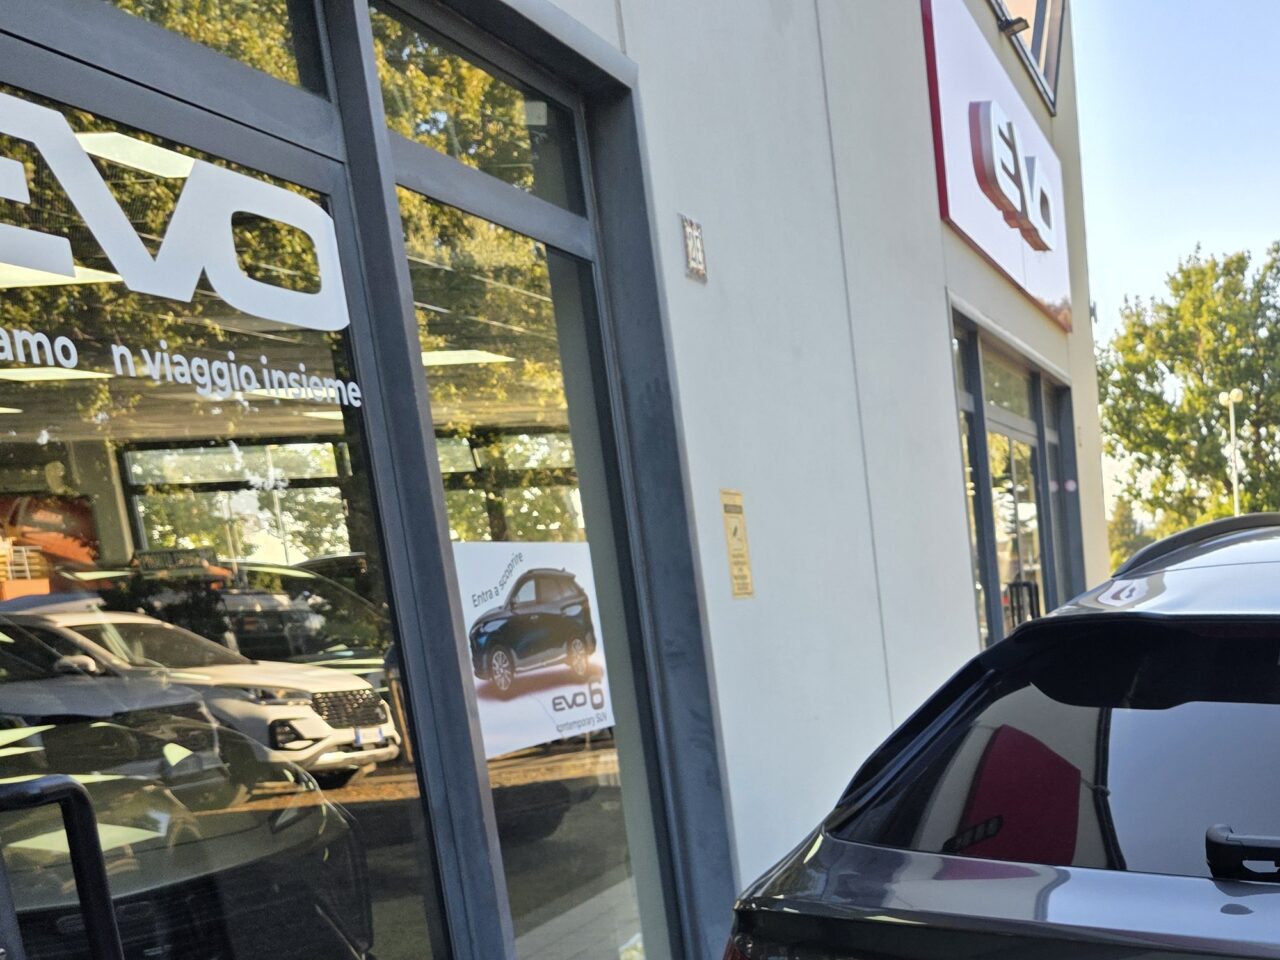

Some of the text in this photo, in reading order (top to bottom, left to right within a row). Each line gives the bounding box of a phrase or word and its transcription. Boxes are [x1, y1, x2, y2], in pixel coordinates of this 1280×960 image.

[142, 339, 260, 398] viaggio
[259, 355, 363, 408] insieme
[471, 588, 493, 608] Entra
[498, 552, 524, 591] scoprire
